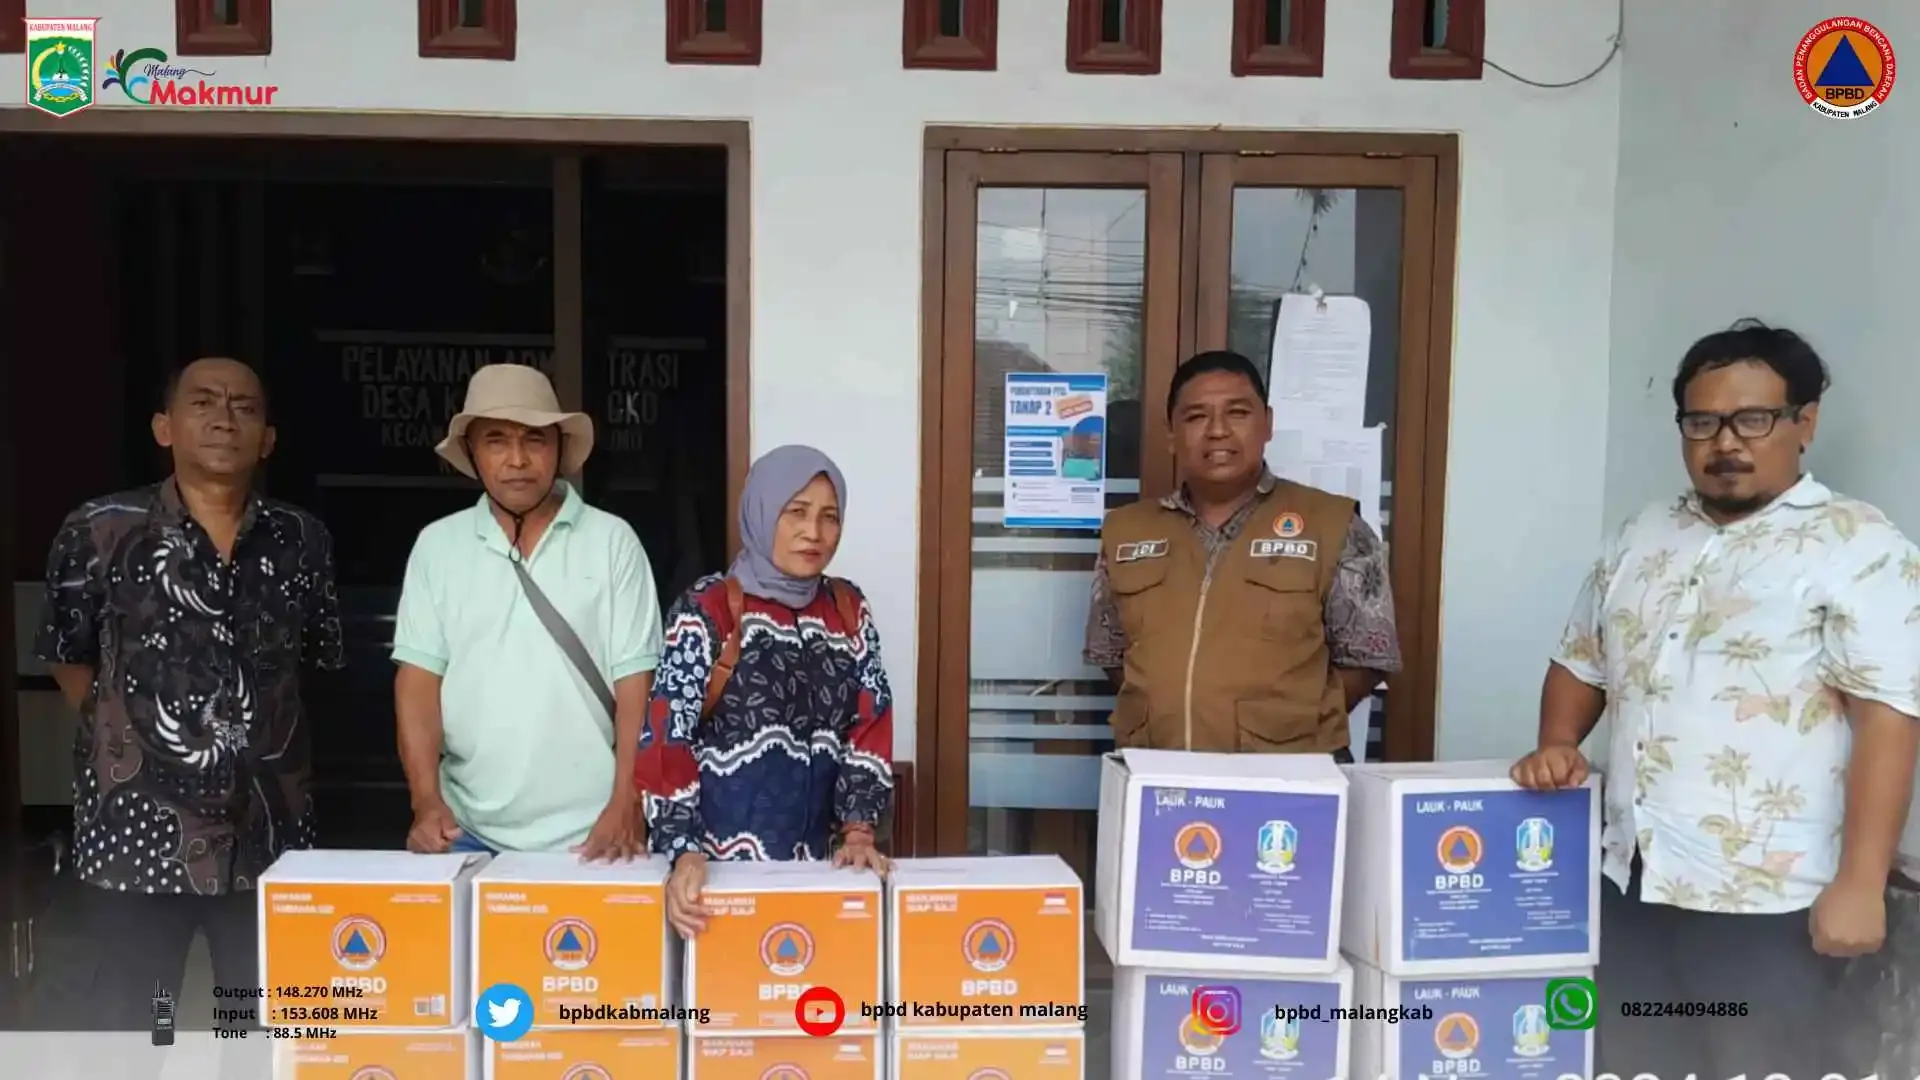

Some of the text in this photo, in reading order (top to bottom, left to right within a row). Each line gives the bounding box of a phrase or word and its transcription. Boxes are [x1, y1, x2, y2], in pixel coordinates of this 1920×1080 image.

[362, 384, 432, 420] DESA
[1010, 400, 1042, 415] TAHAP
[1045, 400, 1052, 416] 2
[1261, 542, 1308, 555] BPBD
[1156, 796, 1186, 807] LAUK
[1195, 796, 1225, 808] PAUK
[1416, 801, 1445, 813] LAUK
[1453, 800, 1483, 812] PAUK
[1170, 869, 1221, 884] BPBD
[1435, 874, 1484, 889] BPBD
[543, 976, 598, 992] BPBD
[758, 983, 812, 1000] BPB
[962, 979, 1018, 995] BPBD
[1160, 983, 1189, 996] LAUK
[1414, 989, 1442, 1000] LAUK
[1452, 985, 1480, 998] PAUK
[1175, 1056, 1226, 1071] BPBD
[1432, 1060, 1481, 1074] BPBD
